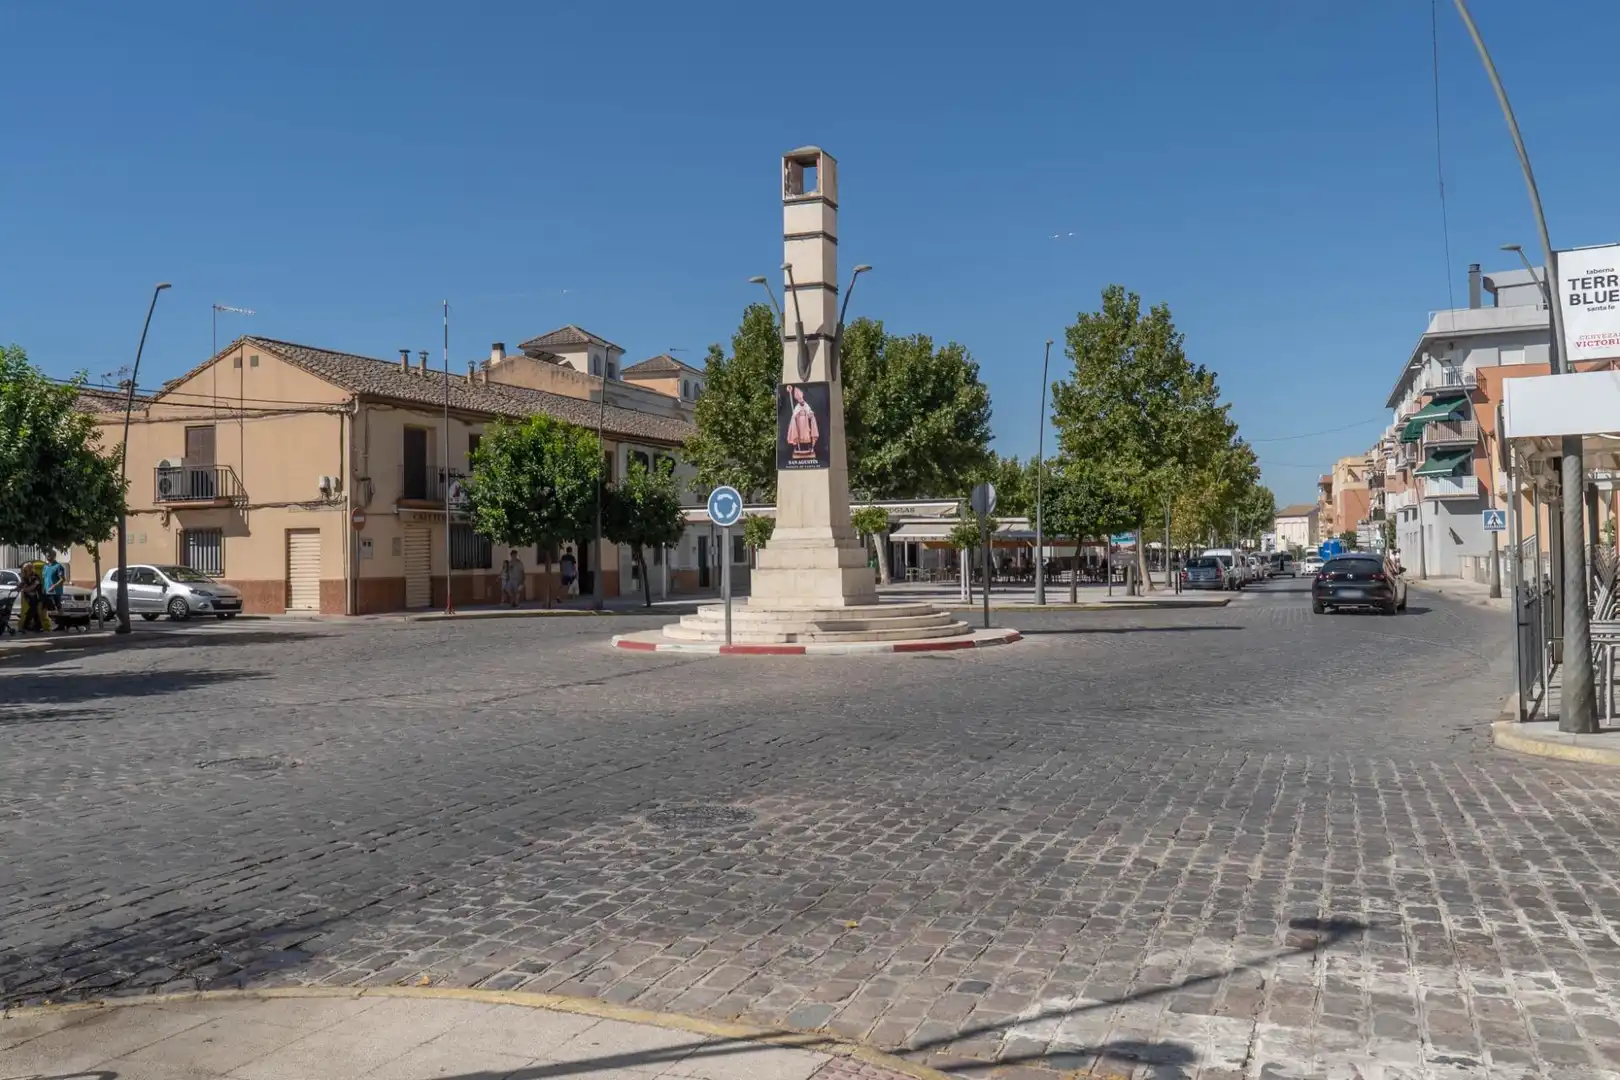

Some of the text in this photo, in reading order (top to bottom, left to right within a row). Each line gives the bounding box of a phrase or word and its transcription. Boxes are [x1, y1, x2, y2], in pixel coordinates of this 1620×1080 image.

[1586, 267, 1615, 275] taberna
[1567, 274, 1619, 291] TERR
[1569, 290, 1620, 306] BLUE
[1586, 305, 1607, 313] santa
[1576, 339, 1620, 348] VICTORI
